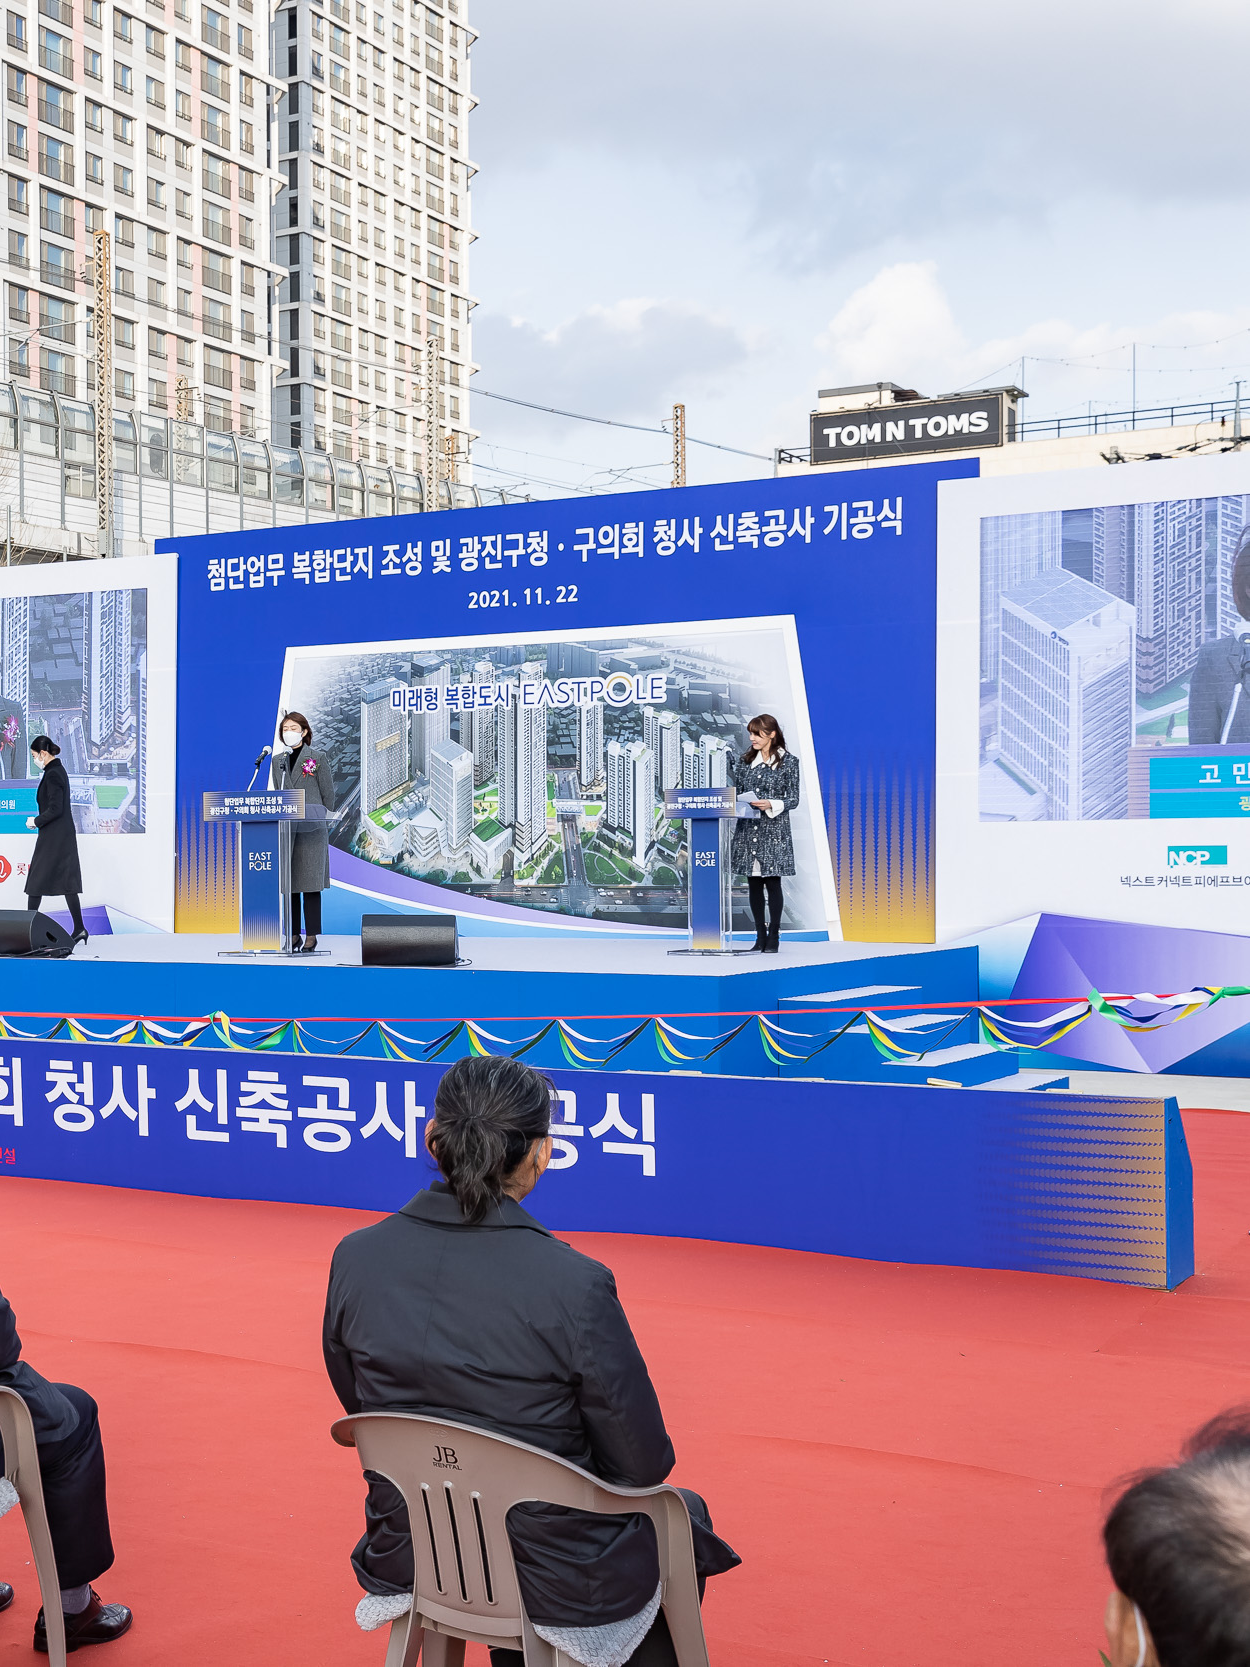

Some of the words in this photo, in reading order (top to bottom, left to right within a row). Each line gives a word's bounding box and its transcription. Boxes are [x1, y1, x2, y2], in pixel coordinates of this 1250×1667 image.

[823, 422, 881, 448] TOM
[885, 420, 905, 442] N
[909, 411, 989, 439] TOMS
[207, 552, 286, 591] 첨단업무
[291, 545, 374, 584] 복합단지
[380, 541, 423, 577] 조성
[430, 538, 452, 574] 및
[458, 530, 549, 572] 광진구청
[573, 521, 645, 562] 구의회
[652, 516, 703, 557] 청사
[709, 505, 815, 551] 신축공사
[822, 496, 903, 541] 기공식
[468, 589, 518, 609] 2021.
[524, 587, 551, 606] 11.
[555, 585, 579, 604] 22
[392, 686, 438, 712] 미래형
[445, 683, 510, 710] 복합도시
[522, 674, 664, 706] EASTPOLE
[248, 851, 272, 861] EAST
[695, 851, 716, 859] EAST
[695, 859, 716, 867] POLE
[1169, 850, 1210, 866] NCP
[248, 861, 272, 871] POLE
[44, 1059, 156, 1137] 청사
[174, 1068, 426, 1159] 신축공사
[548, 1089, 655, 1176] 공식
[432, 1445, 458, 1464] JB
[432, 1461, 463, 1471] RENTAL
